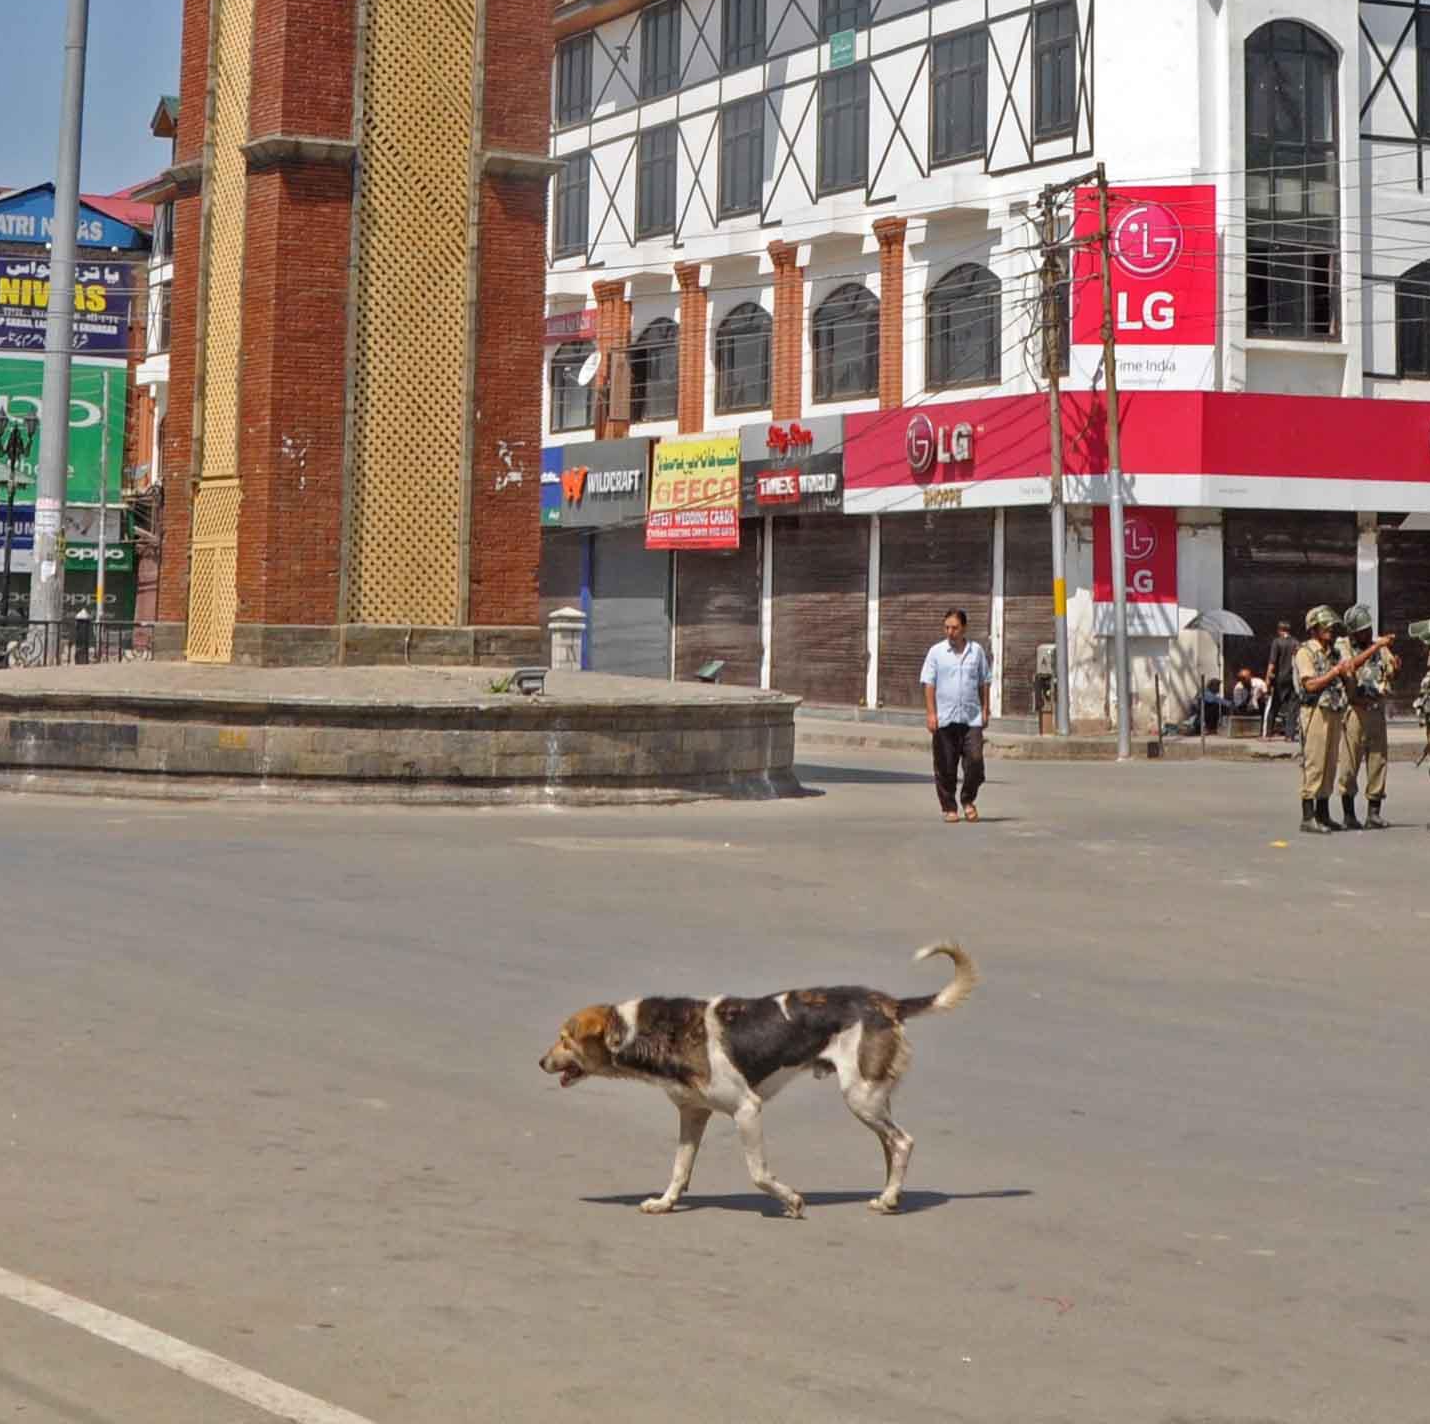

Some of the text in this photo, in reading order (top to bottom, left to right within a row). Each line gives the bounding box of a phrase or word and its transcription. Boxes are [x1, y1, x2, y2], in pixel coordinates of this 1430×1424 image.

[41, 216, 104, 242] NAS
[1117, 291, 1175, 331] LG
[1146, 358, 1176, 372] India
[937, 423, 973, 463] LG
[587, 469, 641, 494] WILDCRAFT
[656, 476, 738, 504] GEECO
